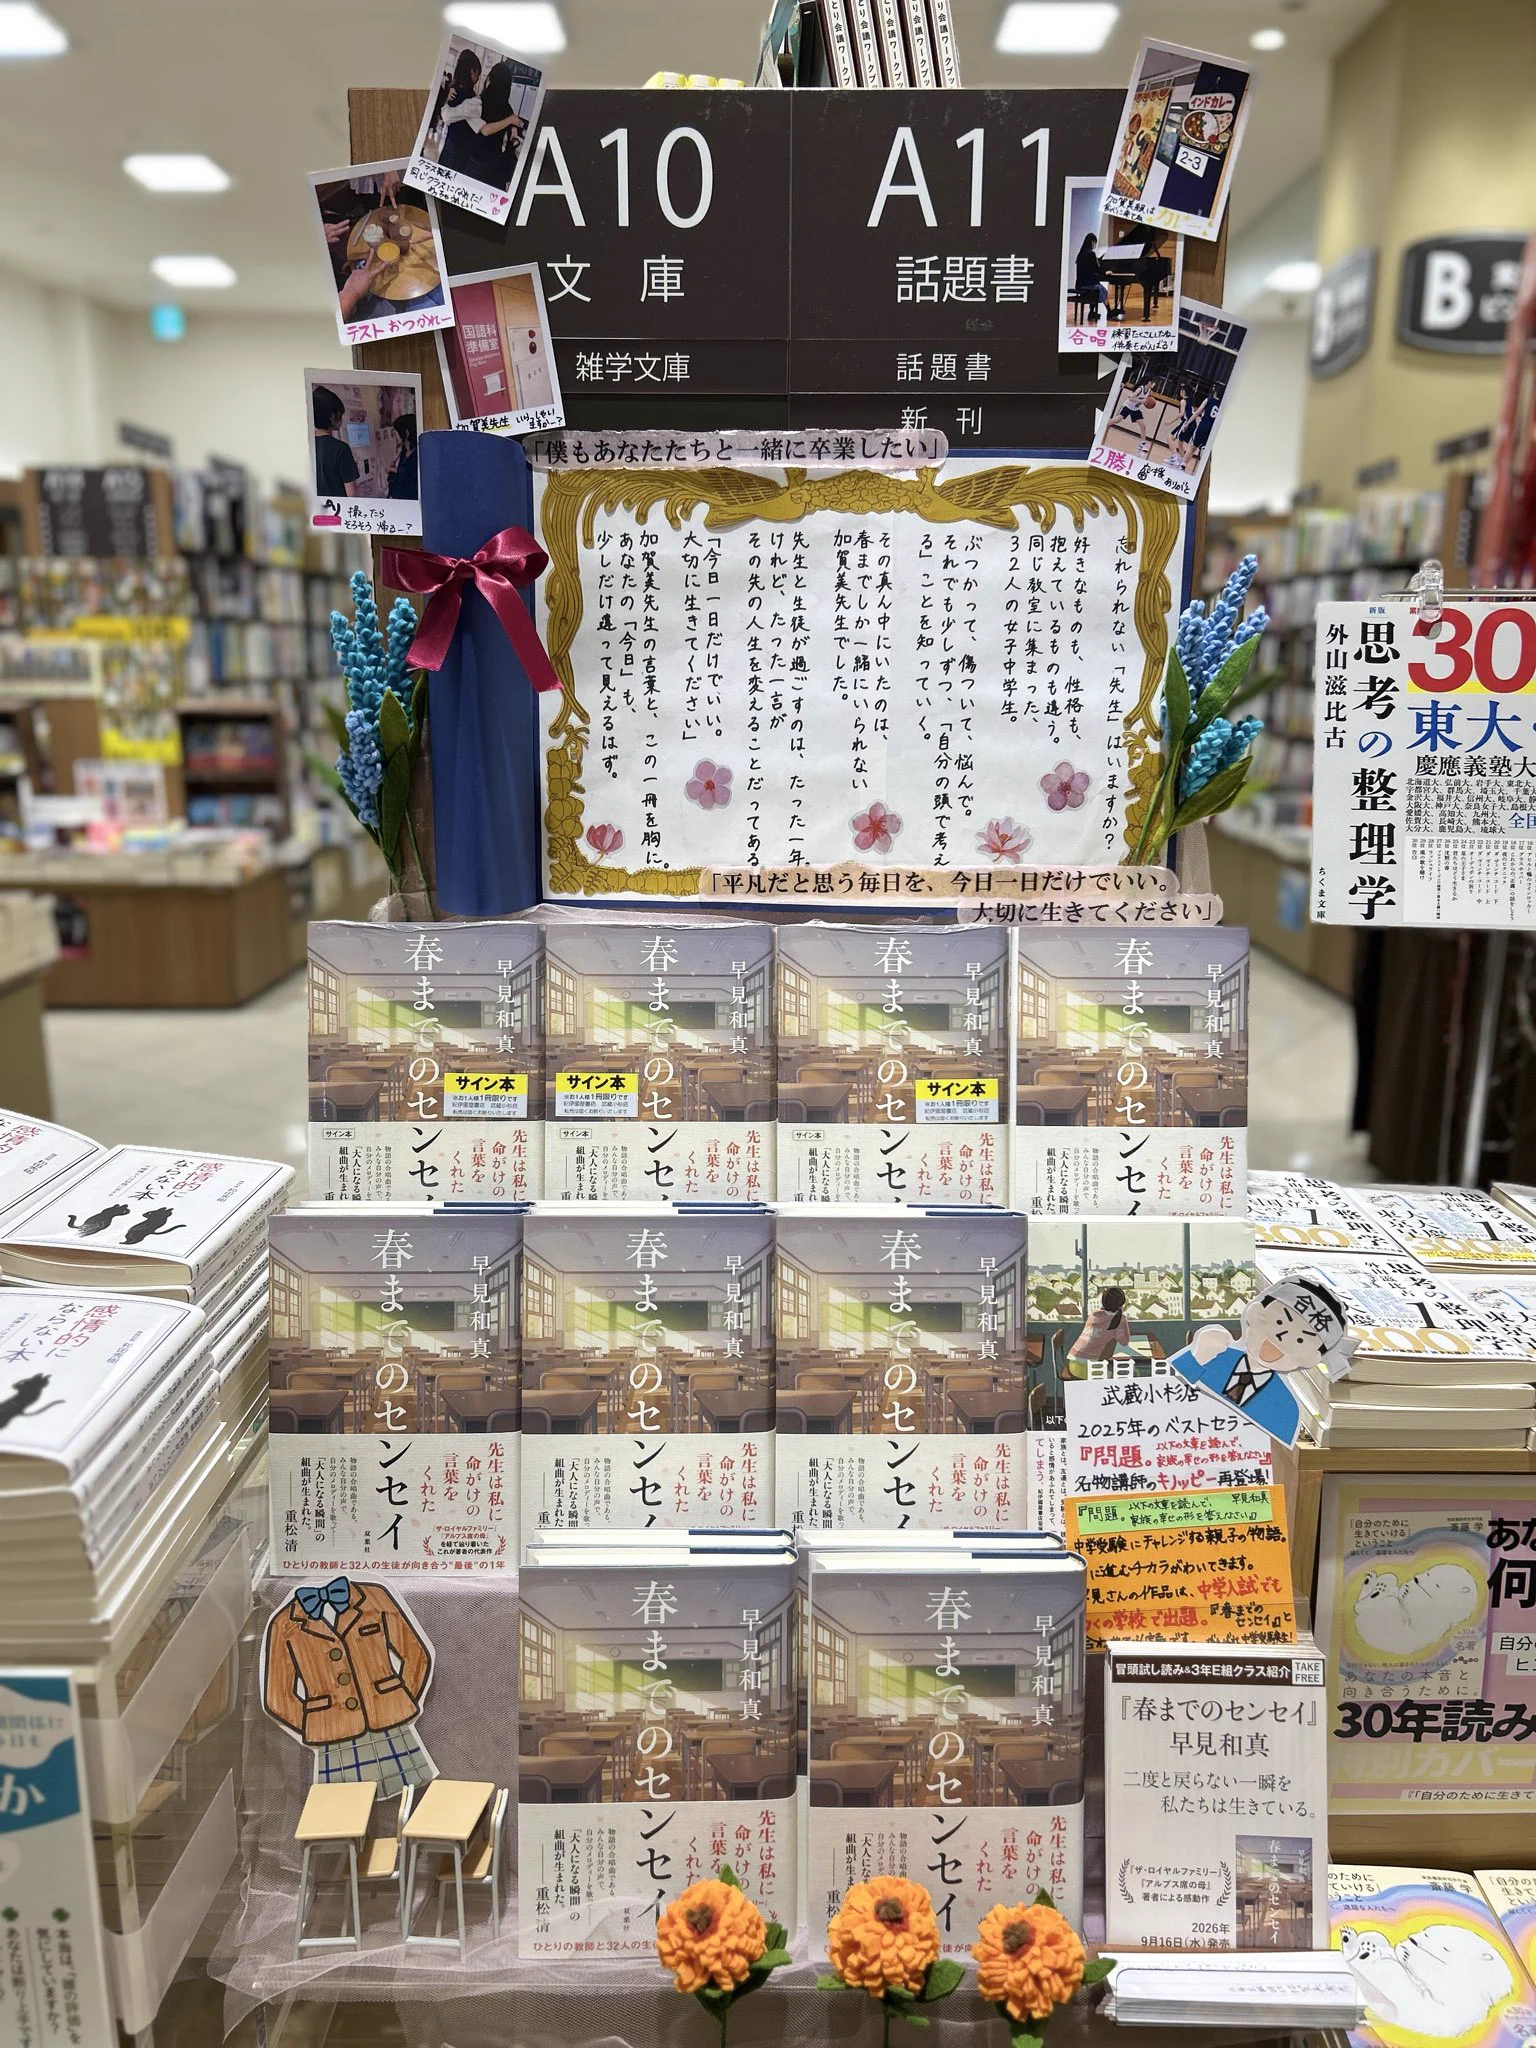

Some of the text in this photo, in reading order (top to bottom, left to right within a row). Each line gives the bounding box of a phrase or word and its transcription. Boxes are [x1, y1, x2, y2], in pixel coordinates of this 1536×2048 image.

[1190, 96, 1233, 110] インドカレー
[515, 127, 714, 228] A10
[867, 127, 1052, 228] A11
[1179, 150, 1203, 170] 2-3
[895, 254, 1034, 303] 話題書
[1420, 250, 1472, 331] B
[462, 323, 497, 340] 国語科
[465, 338, 500, 354] 準備室
[1068, 328, 1108, 347] 合唱
[575, 351, 690, 382] 雑学文庫
[896, 352, 991, 382] 話題書
[532, 436, 938, 465] 「僕もあなたたちと一緒に卒業したい」
[1090, 447, 1134, 476] 2勝!
[618, 531, 638, 713] あなたの「今日」も、
[681, 531, 703, 741] 大切に生きてください」
[703, 537, 724, 737] 「今日一日だけでいい。
[833, 531, 852, 701] 加賀美先生でした。
[874, 533, 893, 741] その真ん中にいたのは、
[915, 533, 935, 741] る」ことを知っていく。
[1000, 535, 1022, 723] 32人の女子中学生。
[1023, 535, 1047, 722] 同じ教室に集まった、
[1063, 535, 1091, 740] 好きなものも、性格も、
[1369, 606, 1386, 615] 新版
[596, 530, 618, 779] 少しだけ違って見えるはず。
[851, 530, 874, 790] 春までしか一緒にいられない
[1043, 536, 1067, 744] 抱えているものも違う。
[746, 532, 765, 867] その先の人生を変えることだってある
[932, 534, 959, 866] それでも少しずつ、「自分の頭で考え
[955, 535, 983, 817] ぶつかって、傷ついて、悩んで。
[1102, 537, 1132, 850] 忘れられない「先生」はいますか?
[1323, 623, 1349, 748] 外山滋比古
[1348, 621, 1401, 921] 思考の整理学
[1414, 754, 1536, 779] 慶應義塾大
[972, 900, 1213, 923] 大切に生きてください」
[1316, 867, 1327, 919] ちくま文庫
[495, 959, 517, 1055] 早見和真
[728, 960, 750, 1056] 早見和真
[962, 962, 984, 1058] 早見和真
[1204, 963, 1225, 1060] 早見和真
[404, 934, 444, 1200] 春までのセンセ
[455, 1076, 516, 1092] サイン本
[566, 1075, 626, 1091] サイン本
[639, 935, 680, 1200] 春までのセンセ
[874, 937, 913, 1201] 春までのセンセ
[927, 1081, 987, 1097] サイン本
[325, 1130, 353, 1138] サイン本
[471, 1138, 486, 1183] 言葉を
[562, 1130, 589, 1138] サイン本
[796, 1131, 822, 1139] サイン本
[450, 1150, 465, 1193] くれた
[492, 1141, 507, 1197] 命がけの
[512, 1129, 528, 1201] 先生は私に
[1157, 1156, 1172, 1200] くれた
[1178, 1144, 1194, 1189] 言葉を
[1199, 1147, 1214, 1204] 命がけの
[1219, 1135, 1234, 1209] 先生は私に
[0, 1302, 84, 1363] ならない本
[45, 1304, 122, 1358] 感情的に
[469, 1255, 492, 1359] 早見和真
[723, 1255, 745, 1359] 早見和真
[977, 1256, 999, 1361] 早見和真
[1293, 1294, 1334, 1334] 合格
[371, 1229, 414, 1551] 春までのセンセイ
[1101, 1383, 1201, 1406] 武蔵小杉店
[1078, 1415, 1257, 1439] 2025年のベストセラー
[300, 1457, 312, 1530] 組曲が生まれた。
[314, 1457, 326, 1541] 「大人になる瞬間」の
[420, 1465, 438, 1513] くれた
[443, 1452, 459, 1501] 言葉を
[466, 1455, 482, 1516] 命がけの
[487, 1441, 505, 1521] 先生は私に
[927, 1464, 944, 1514] くれた
[950, 1453, 967, 1501] 言葉を
[972, 1455, 989, 1517] 命がけの
[994, 1442, 1011, 1522] 先生は私に
[1232, 1490, 1270, 1505] 早見和真
[1355, 1539, 1393, 1548] ということ
[1197, 1575, 1283, 1601] 中学入試でも
[738, 1608, 763, 1722] 早見和真
[1031, 1615, 1056, 1727] 早見和真
[1115, 1663, 1291, 1679] 冒頭試し読み&3年E組クラス紹介
[1295, 1662, 1320, 1672] TAKE
[1295, 1673, 1320, 1683] FREE
[1342, 1686, 1480, 1699] 向き合うために。
[1343, 1668, 1469, 1682] あなたの本音と
[1121, 1695, 1317, 1726] 『春までのセンセイ』
[631, 1581, 679, 1925] 春までのセンセイ
[925, 1587, 973, 1932] 春までのセンセイ
[1169, 1731, 1270, 1757] 早見和真
[1123, 1770, 1291, 1792] 二度と戻らない一瞬を
[1160, 1795, 1316, 1819] 私たちは生きている。
[758, 1809, 776, 1896] 先生は私に
[976, 1841, 993, 1892] くれた
[1001, 1827, 1019, 1879] 言葉を
[1026, 1830, 1043, 1894] 命がけの
[1050, 1815, 1067, 1900] 先生は私に
[1141, 1892, 1210, 1904] 著者による感動作
[1141, 1936, 1230, 1949] 9月16日(水)発売
[1192, 1922, 1230, 1935] 2026年
